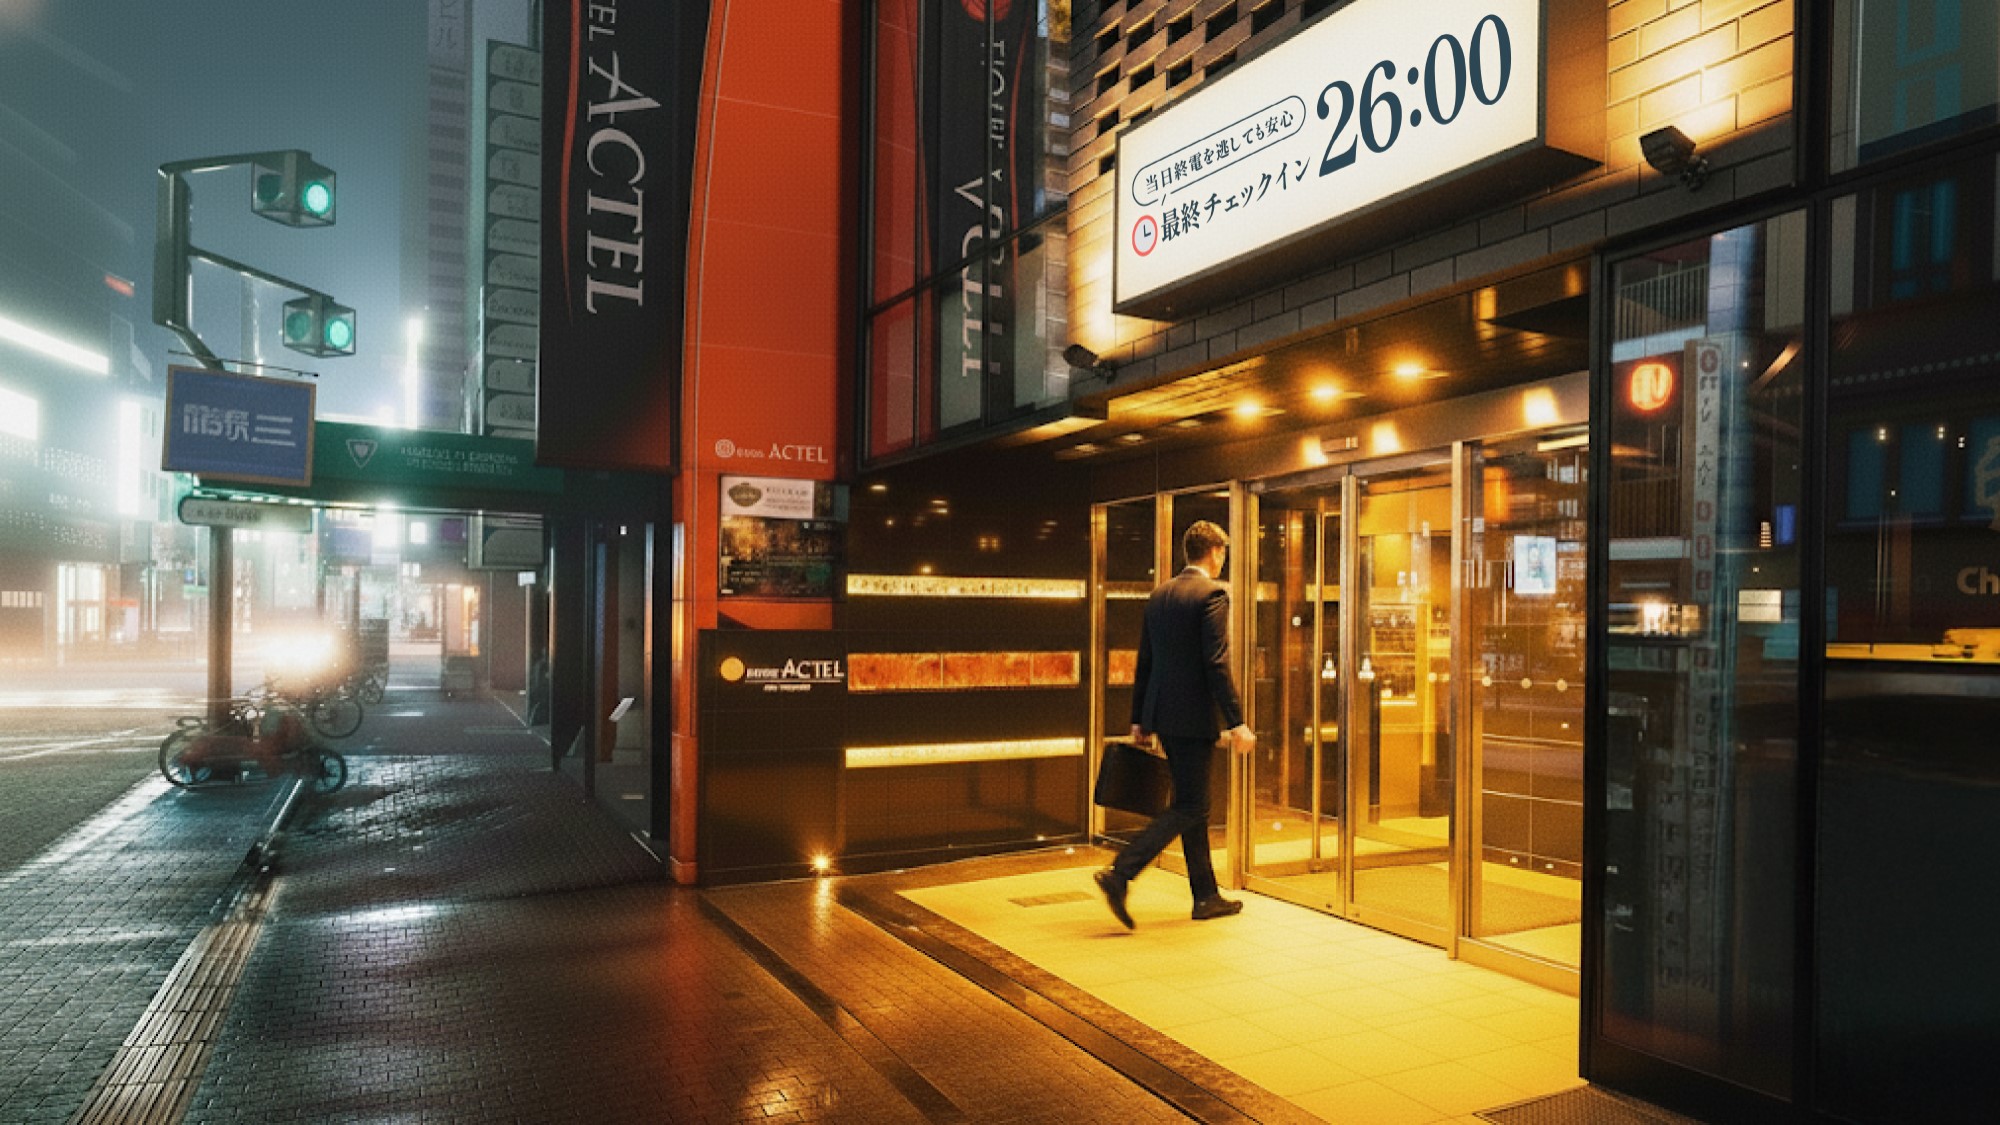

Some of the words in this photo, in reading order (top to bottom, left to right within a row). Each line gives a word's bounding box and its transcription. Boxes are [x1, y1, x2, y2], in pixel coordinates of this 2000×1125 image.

[1145, 110, 1294, 194] 当日終電を逃しても安心
[1160, 156, 1311, 242] 最終チェックイン
[1316, 14, 1512, 177] 26:00
[587, 50, 660, 314] ACTEL
[768, 442, 828, 464] ACTEL
[782, 658, 845, 679] ACTEL
